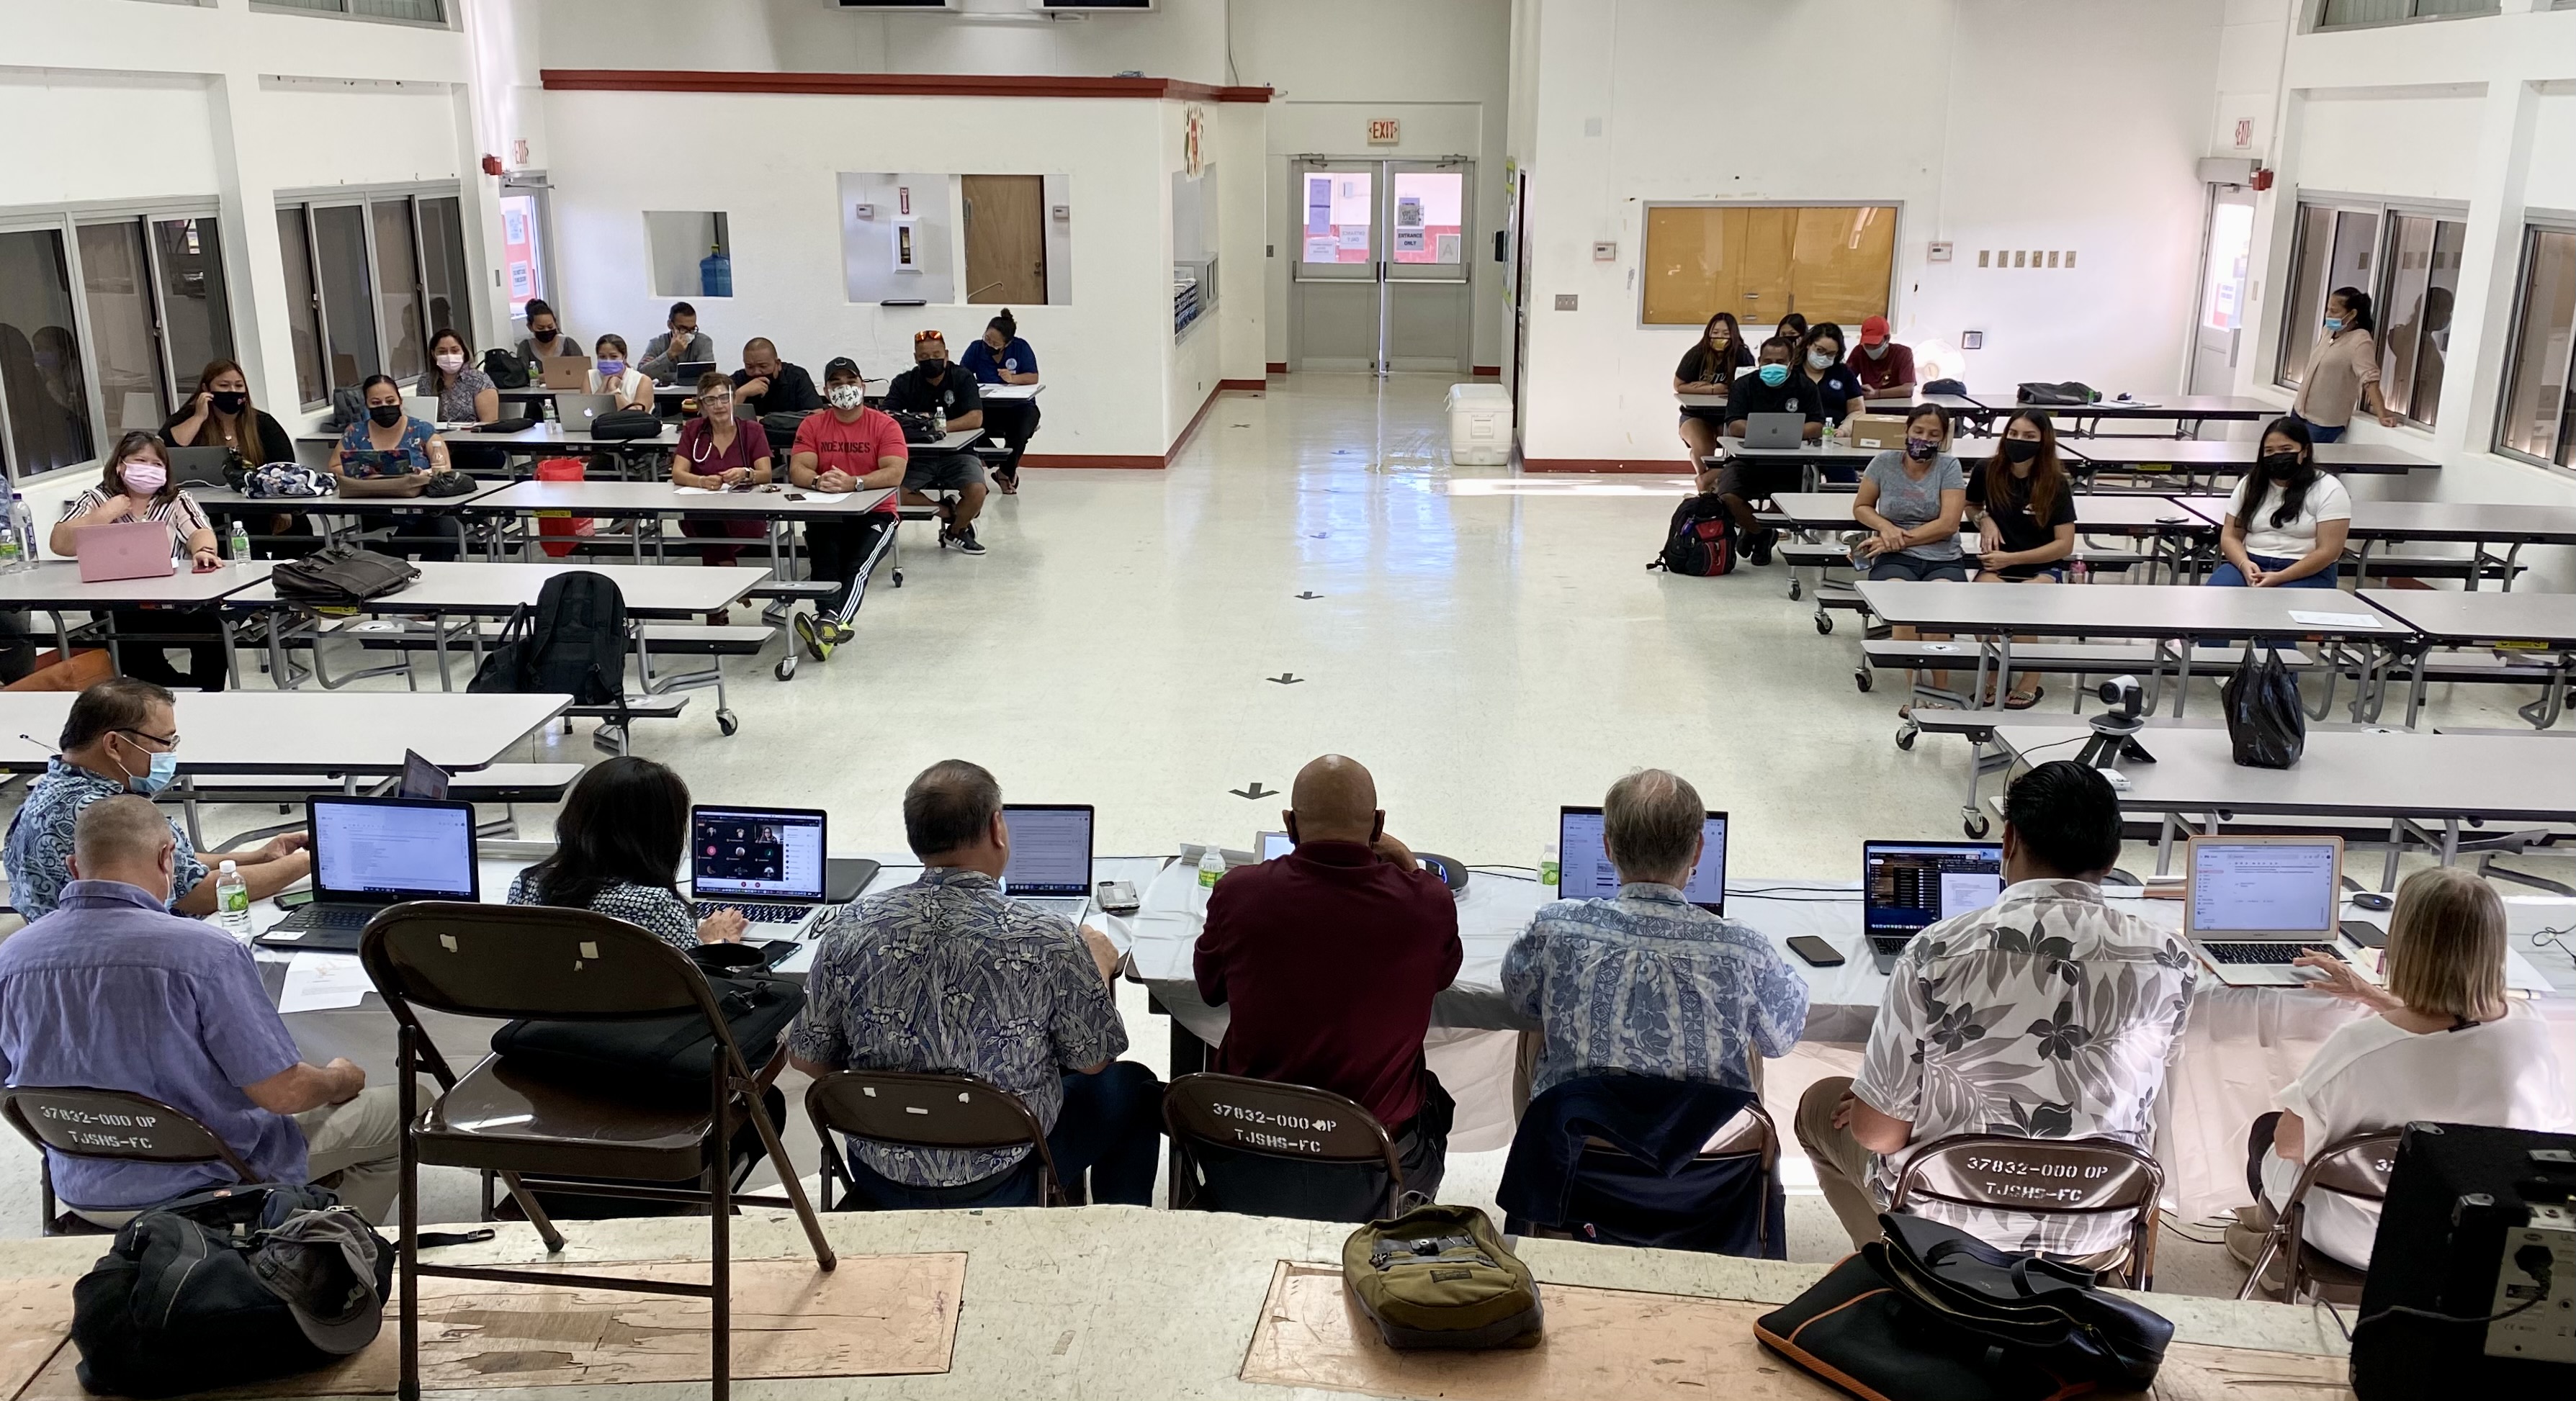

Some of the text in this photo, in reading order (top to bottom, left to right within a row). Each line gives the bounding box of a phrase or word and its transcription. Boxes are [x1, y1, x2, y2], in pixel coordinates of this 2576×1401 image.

[1373, 121, 1396, 139] EXIT
[514, 140, 528, 164] EXIT
[40, 1106, 132, 1127] 37832-000
[1213, 1102, 1310, 1130] 37832-000
[68, 1130, 153, 1149] TJSHS-FC
[1234, 1127, 1321, 1153] TJSHS-FC
[1967, 1157, 2078, 1179] 37832-000
[1985, 1181, 2083, 1202] TJSHS-FC
